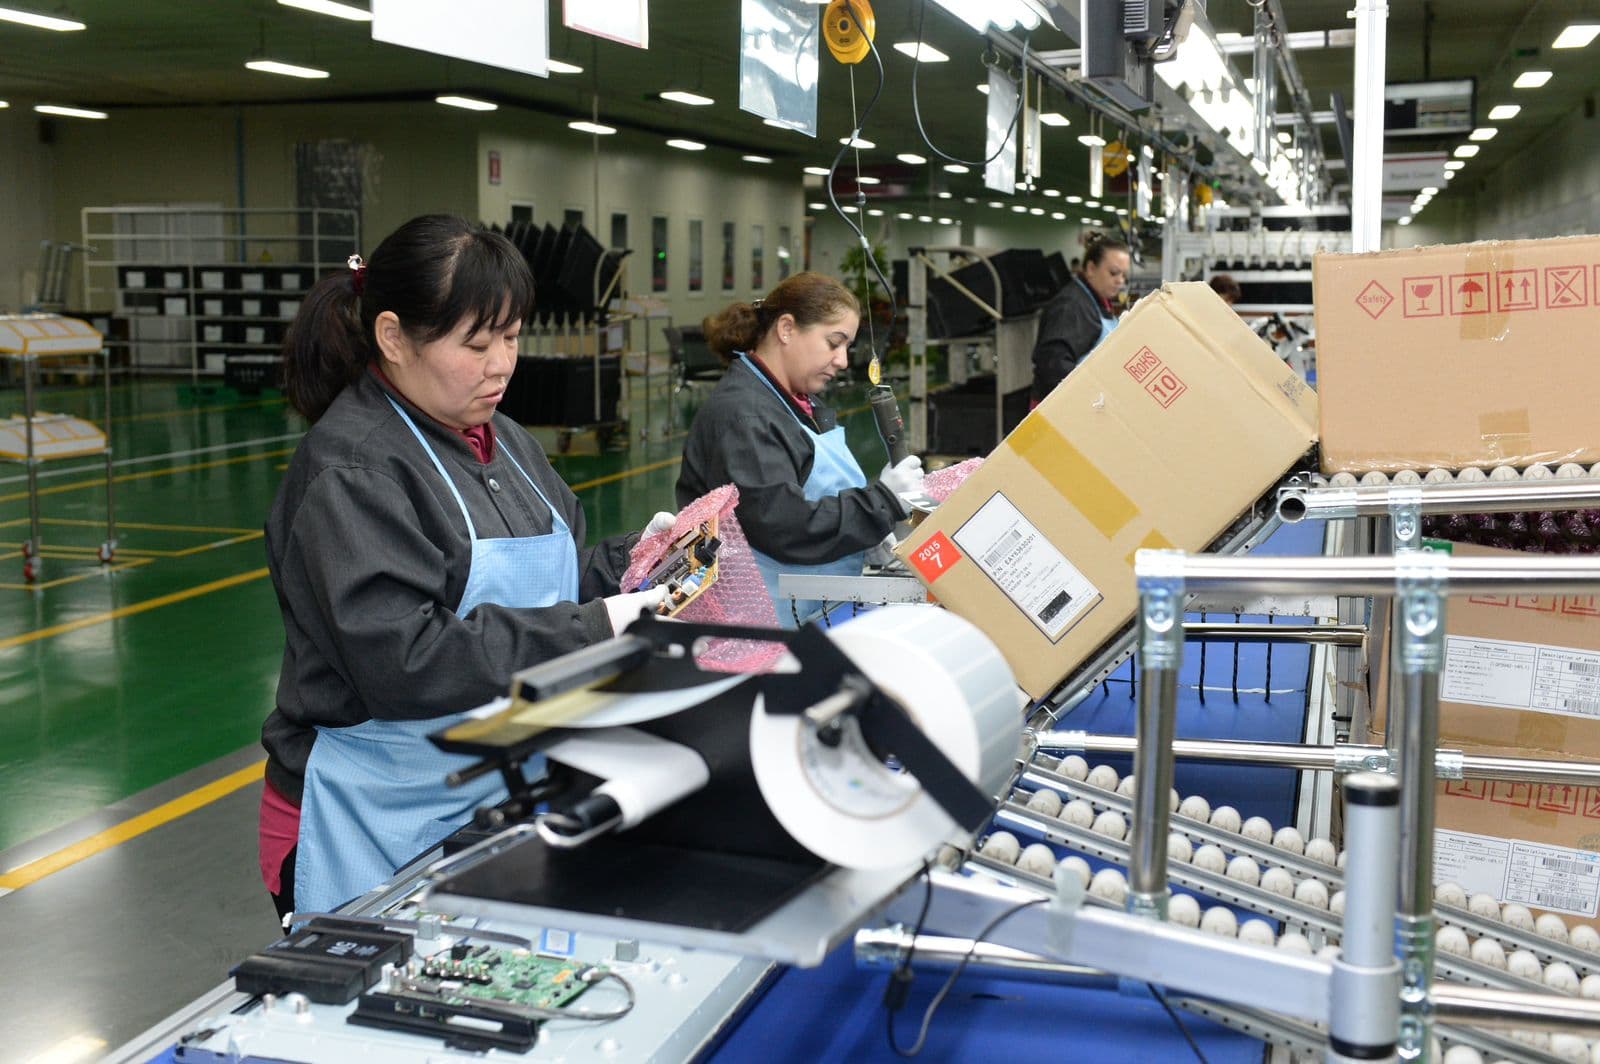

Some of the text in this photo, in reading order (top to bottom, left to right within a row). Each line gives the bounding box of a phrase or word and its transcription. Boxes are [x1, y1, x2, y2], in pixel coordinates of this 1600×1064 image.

[1362, 294, 1387, 305] Safety
[1129, 351, 1157, 379] RoHS
[1152, 374, 1177, 398] 10
[918, 540, 941, 561] 2015
[930, 552, 943, 569] 7
